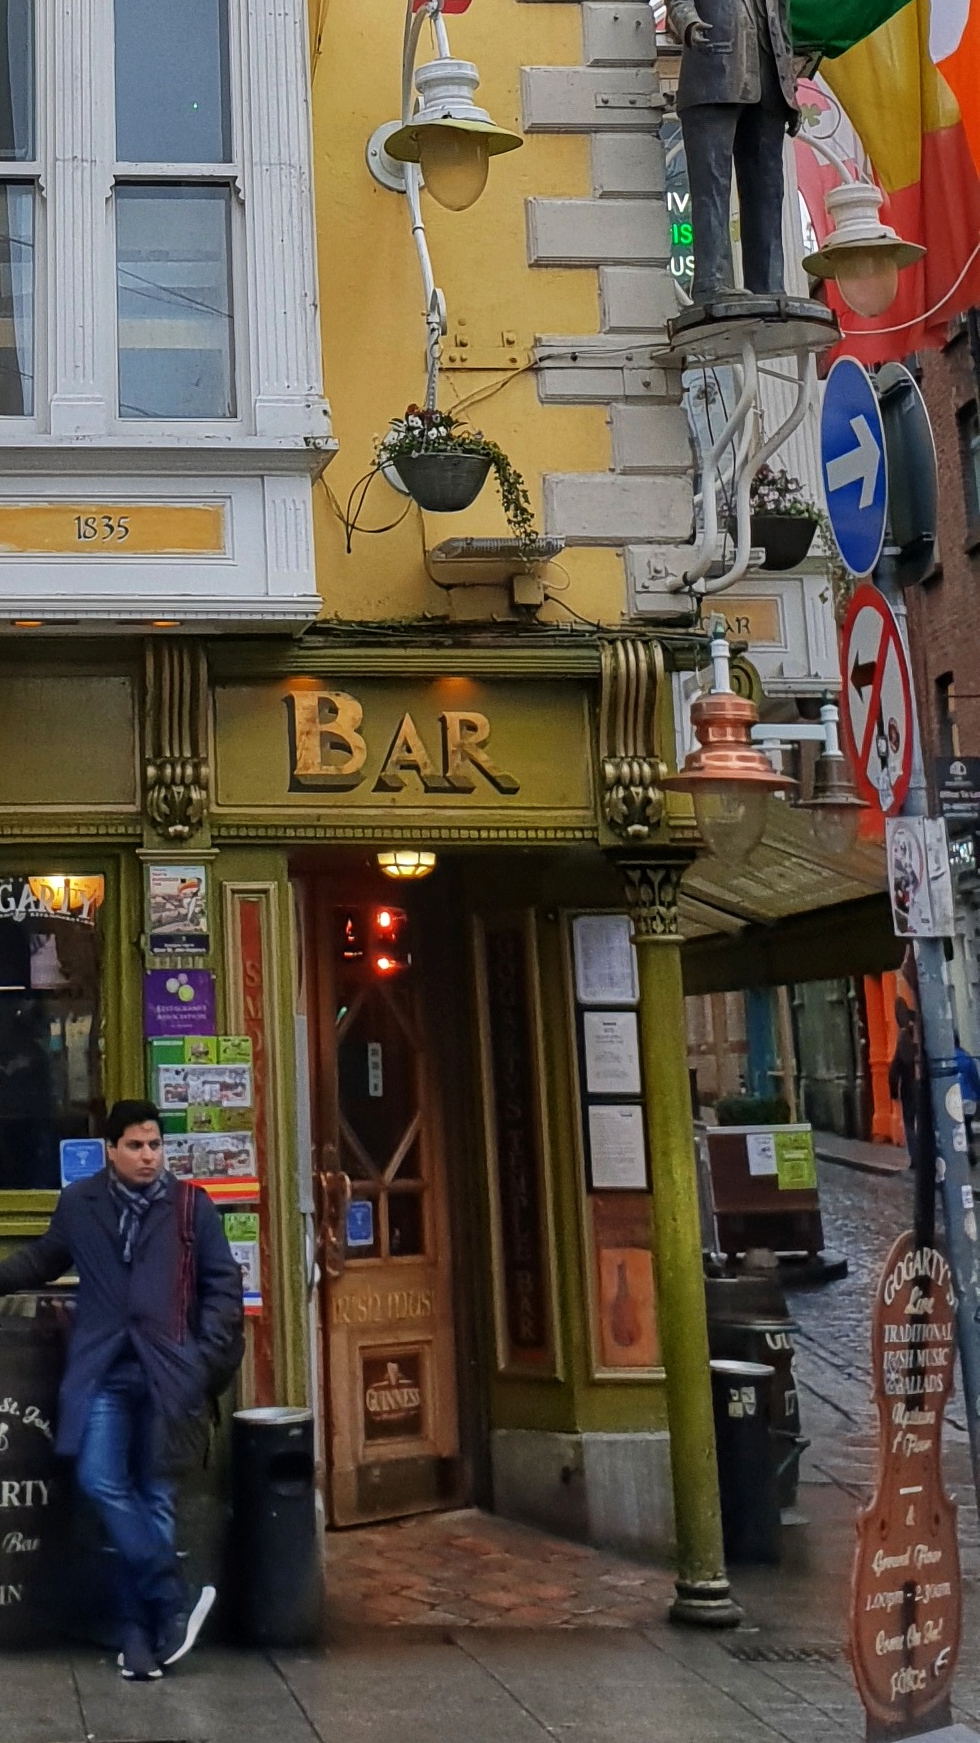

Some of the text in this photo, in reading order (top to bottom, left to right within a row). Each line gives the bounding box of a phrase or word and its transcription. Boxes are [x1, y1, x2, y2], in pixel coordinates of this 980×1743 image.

[74, 514, 131, 544] 1835
[884, 1321, 954, 1344] TRADITIONAL
[916, 1347, 950, 1368] MUSIC
[2, 1531, 41, 1553] Bar
